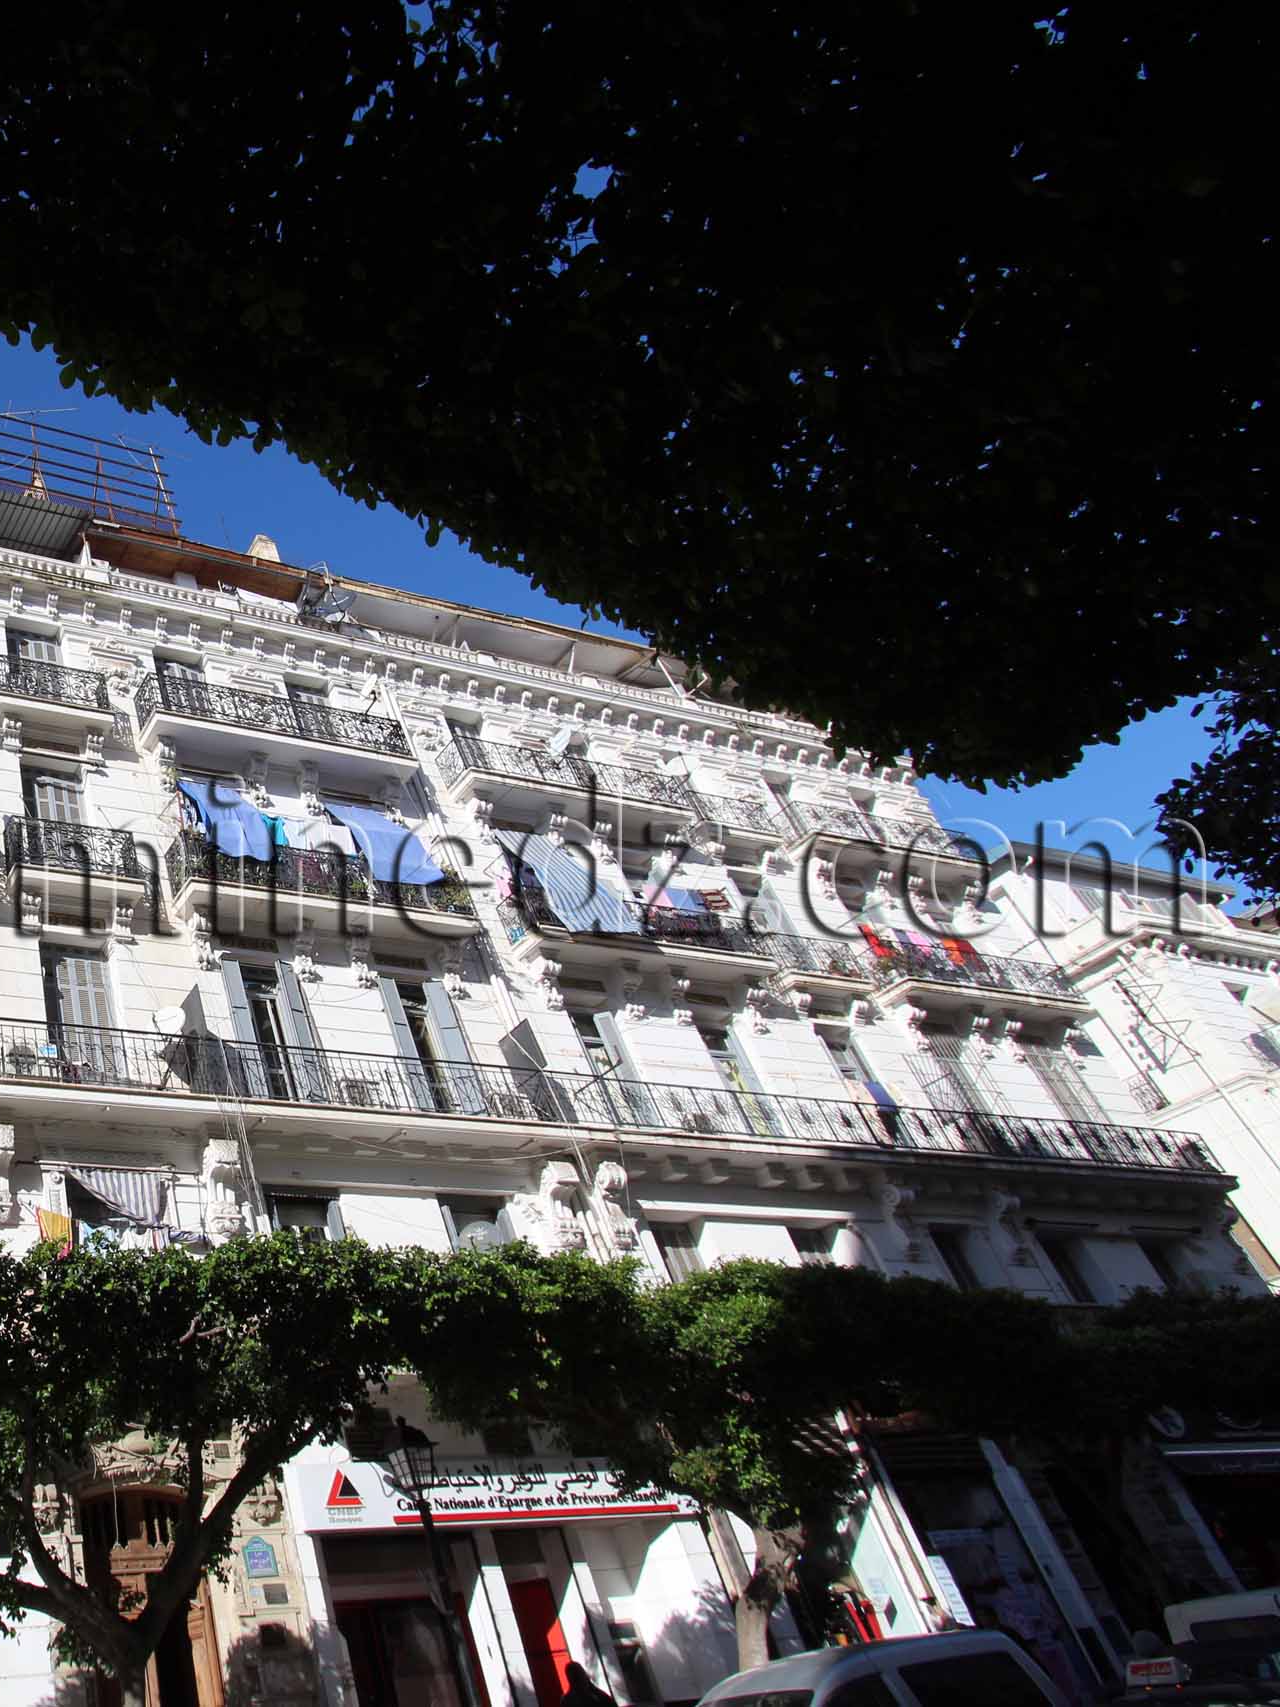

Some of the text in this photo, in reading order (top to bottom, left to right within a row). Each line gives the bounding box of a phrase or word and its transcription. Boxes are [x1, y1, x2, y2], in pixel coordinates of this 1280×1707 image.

[434, 1496, 486, 1510] Nationale
[544, 1493, 556, 1505] et
[557, 1491, 570, 1505] de
